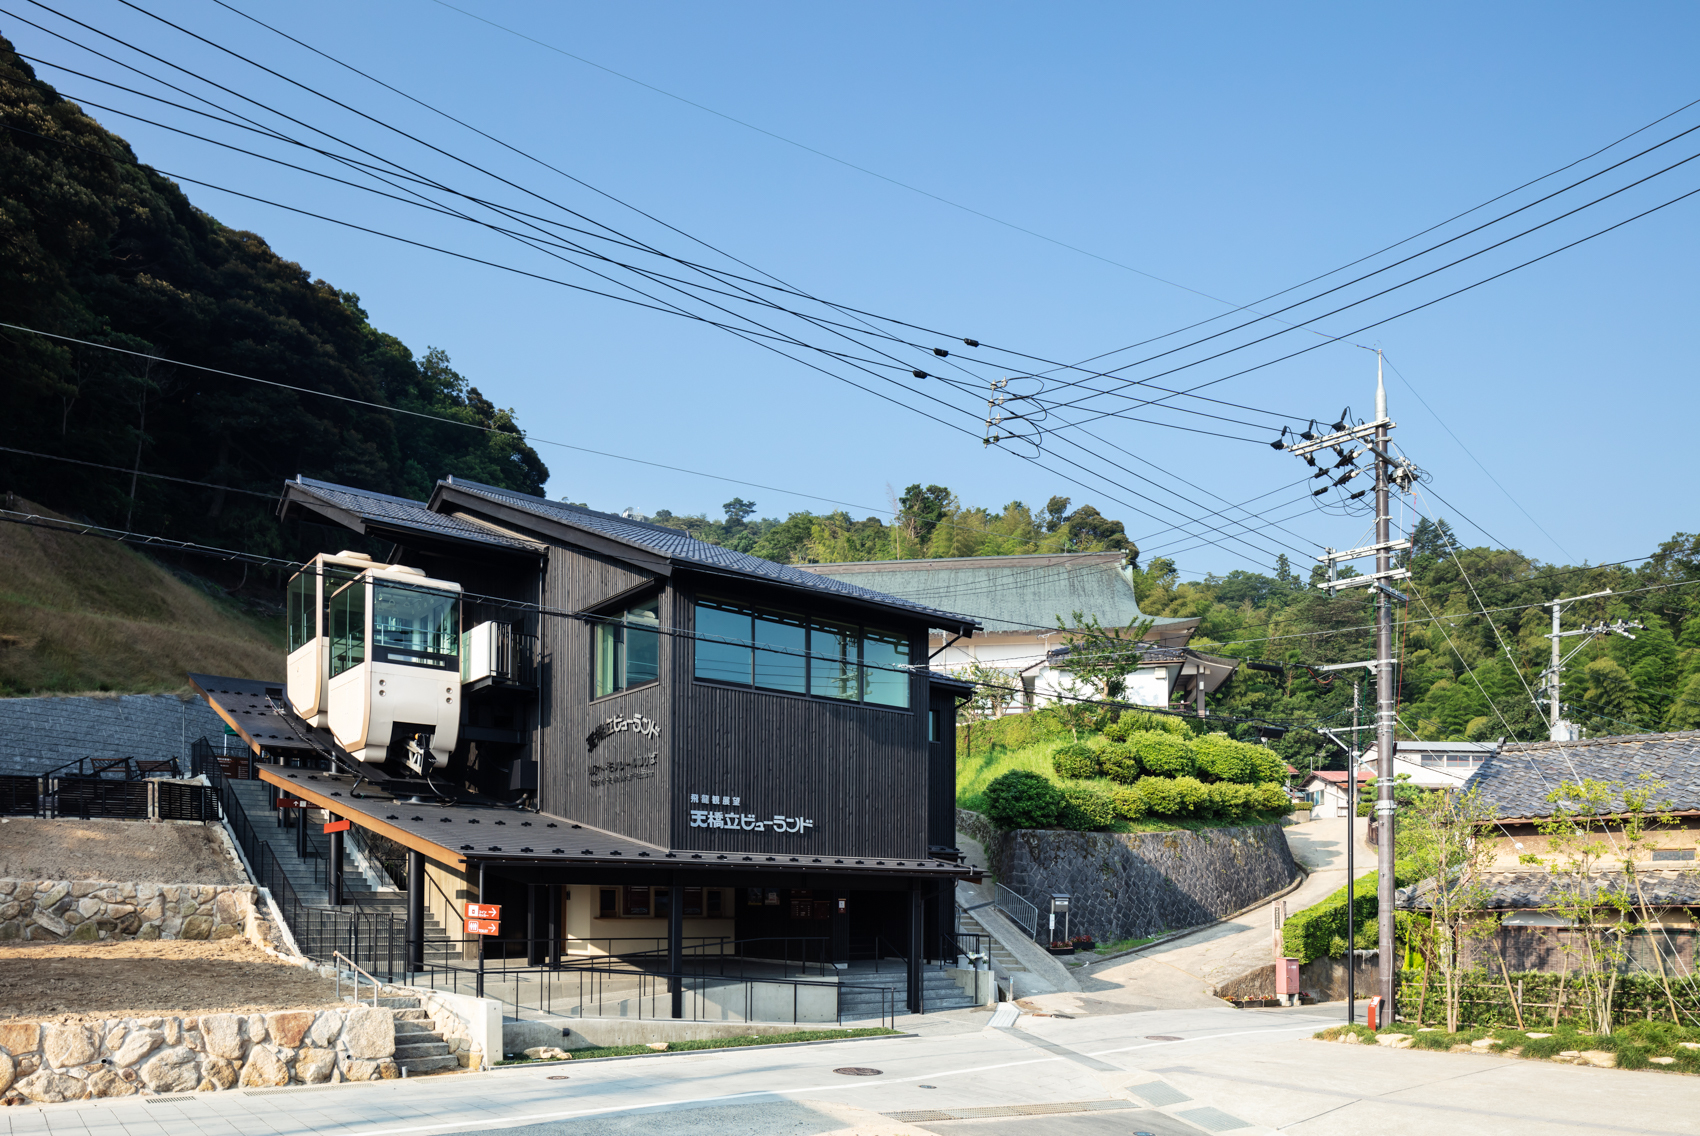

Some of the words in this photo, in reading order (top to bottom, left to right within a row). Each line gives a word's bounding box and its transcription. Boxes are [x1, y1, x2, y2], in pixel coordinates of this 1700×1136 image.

[690, 794, 741, 806] 飛龍観展望
[690, 810, 813, 833] 天橋立ビューランド
